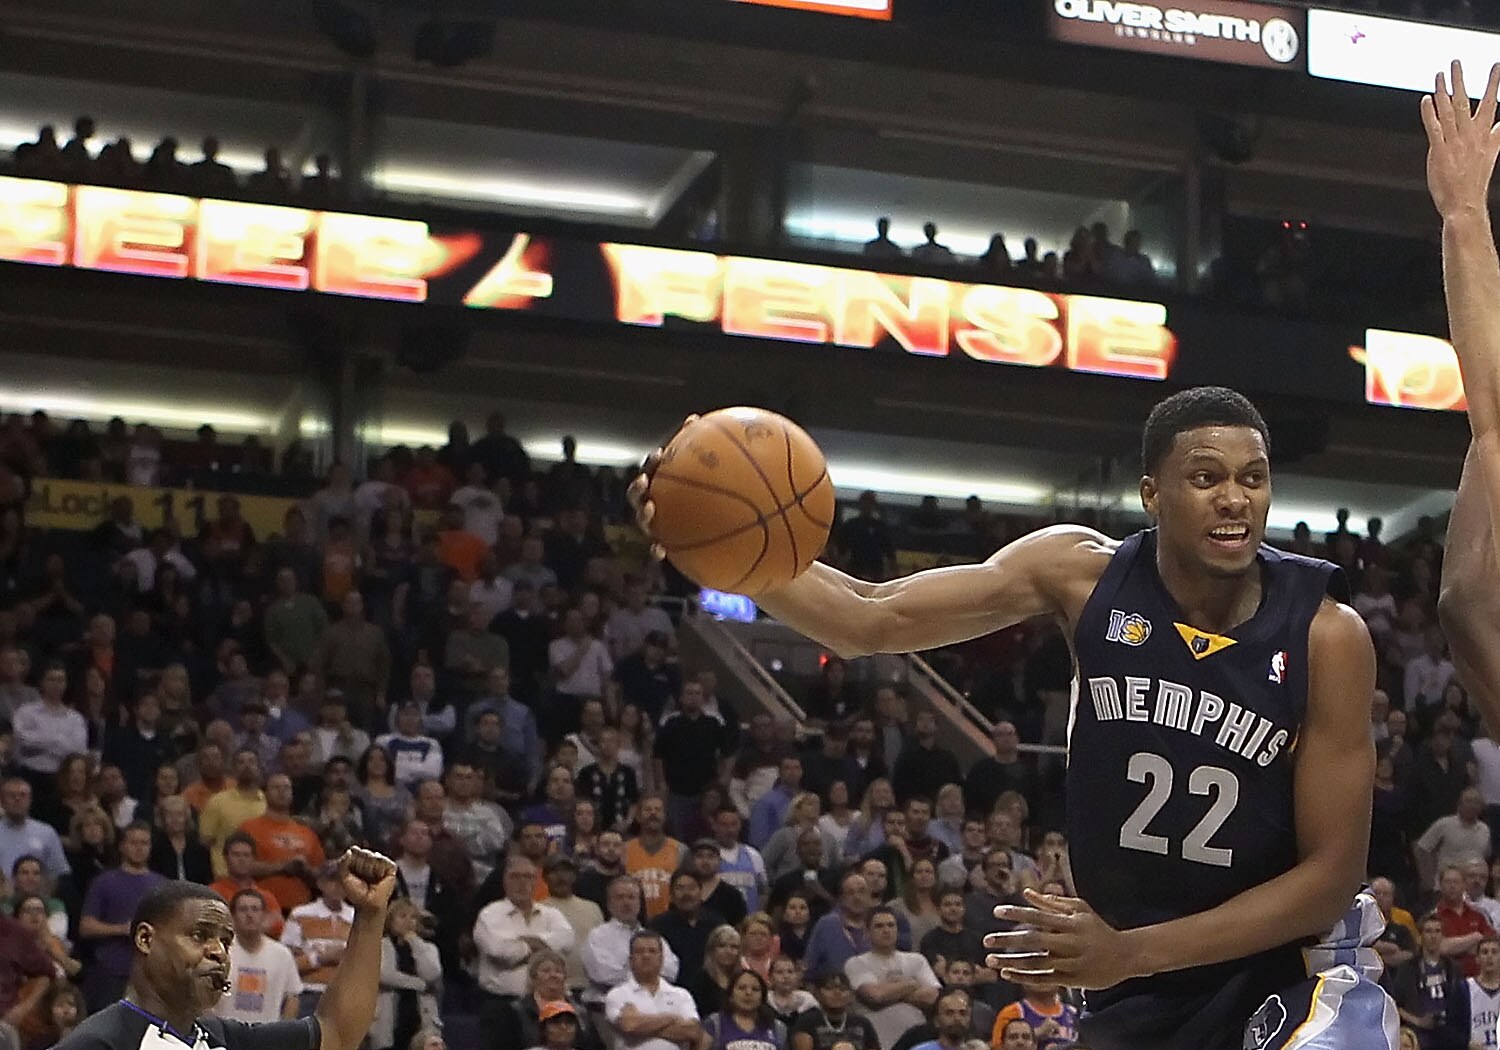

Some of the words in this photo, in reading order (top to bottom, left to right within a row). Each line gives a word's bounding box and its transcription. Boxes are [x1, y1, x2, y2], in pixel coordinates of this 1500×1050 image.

[1055, 0, 1163, 29] OLIVER
[1165, 8, 1260, 43] SMITH
[600, 242, 1169, 381] FENSE
[1089, 675, 1289, 767] MEMPHIS
[1119, 752, 1239, 868] 22
